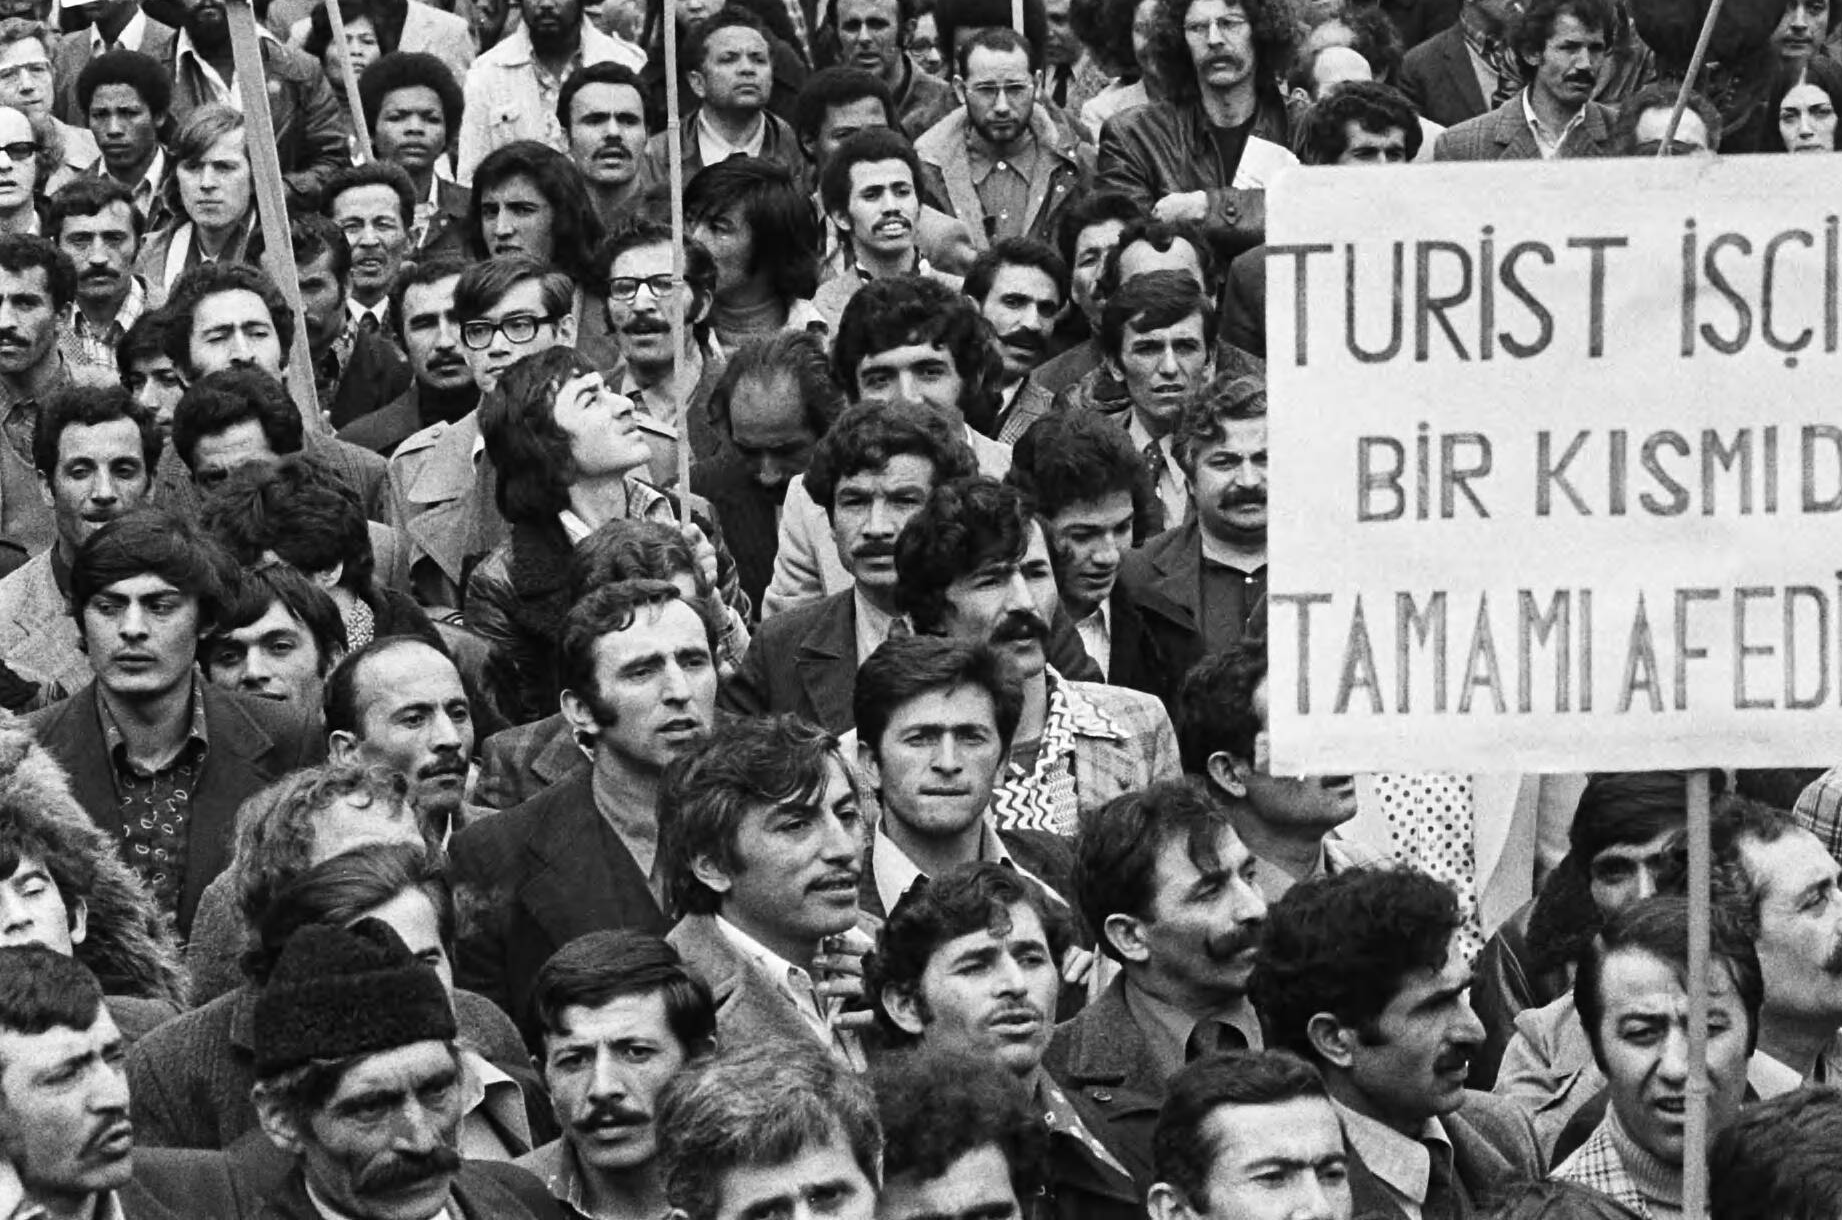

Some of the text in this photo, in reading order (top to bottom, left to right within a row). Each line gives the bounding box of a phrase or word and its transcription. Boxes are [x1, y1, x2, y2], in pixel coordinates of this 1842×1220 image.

[1265, 225, 1629, 367] TURİST
[1357, 421, 1493, 523] BİR
[1535, 424, 1778, 517] KISMI
[1269, 589, 1593, 716] TAMAMI
